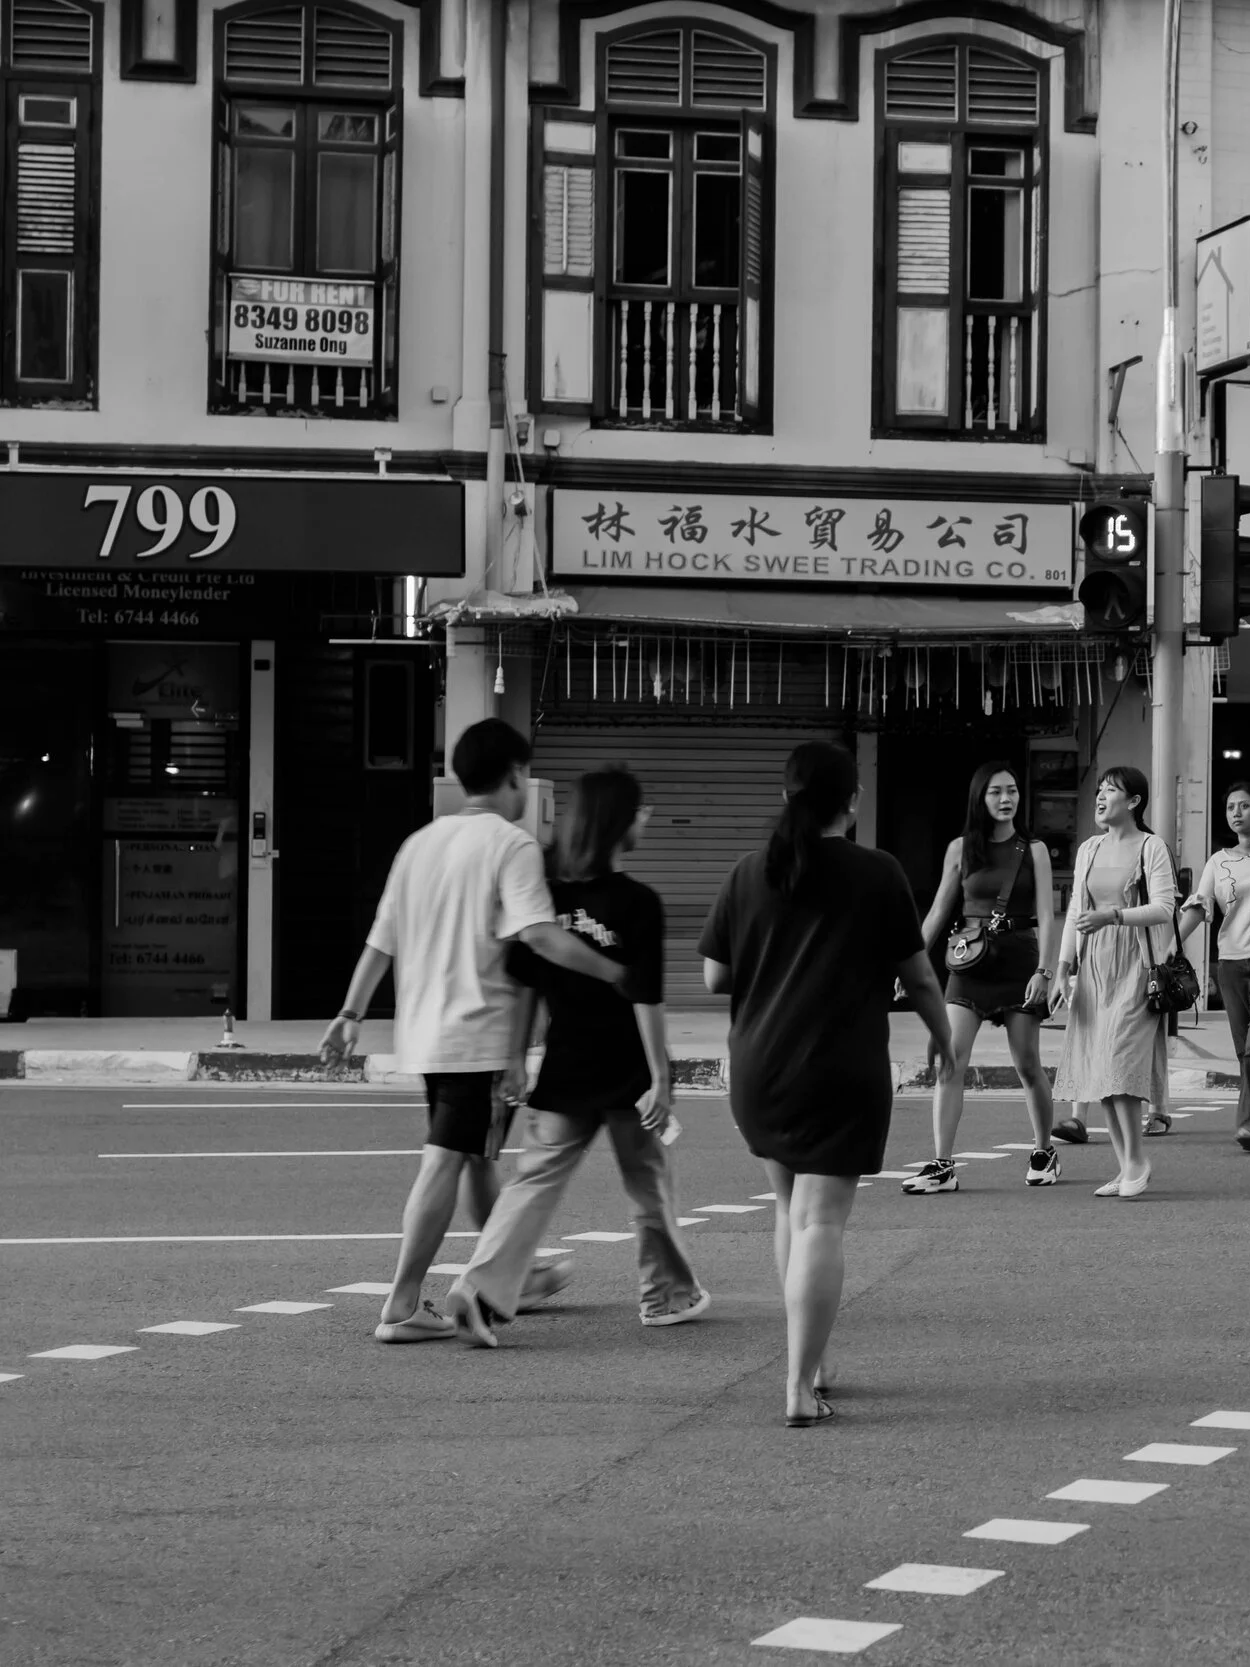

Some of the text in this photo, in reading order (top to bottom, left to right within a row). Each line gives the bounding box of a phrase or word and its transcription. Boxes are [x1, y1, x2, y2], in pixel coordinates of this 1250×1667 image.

[234, 304, 369, 335] 8349 8098
[255, 333, 347, 355] Suzanne Ong
[84, 485, 236, 559] 799
[581, 501, 1029, 555] 林福水貿易公司
[1107, 514, 1136, 552] 15
[582, 549, 1036, 580] LIM HOCK SWEE TRADING CO.
[1045, 569, 1067, 581] 801
[46, 582, 231, 603] Licensed Moneylender
[77, 608, 199, 626] Tel: 6744 4466
